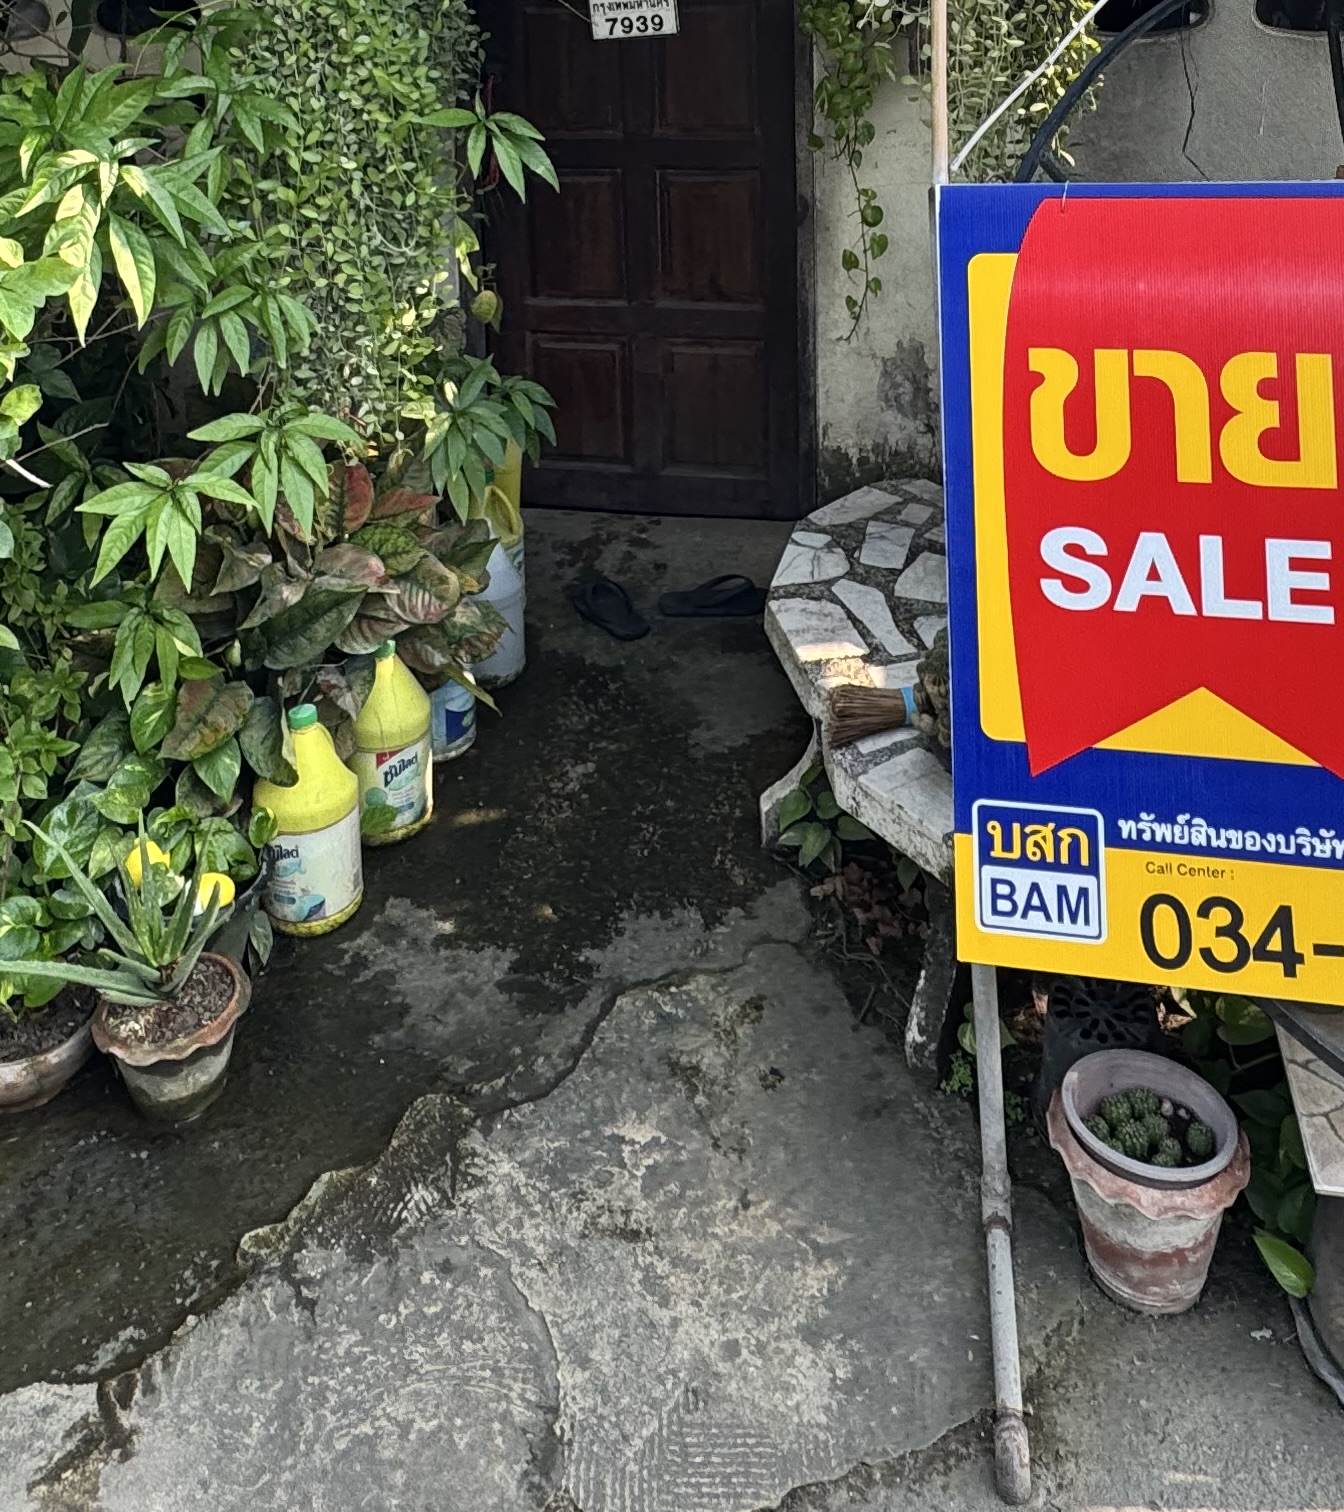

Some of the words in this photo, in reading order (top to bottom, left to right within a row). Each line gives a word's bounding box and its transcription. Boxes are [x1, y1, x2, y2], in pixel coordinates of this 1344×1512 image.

[604, 13, 664, 36] 7939
[1027, 347, 1338, 489] ขาย
[1039, 525, 1336, 625] SALE
[986, 818, 1091, 867] บสก
[1145, 859, 1174, 877] Call
[989, 876, 1093, 928] BAM
